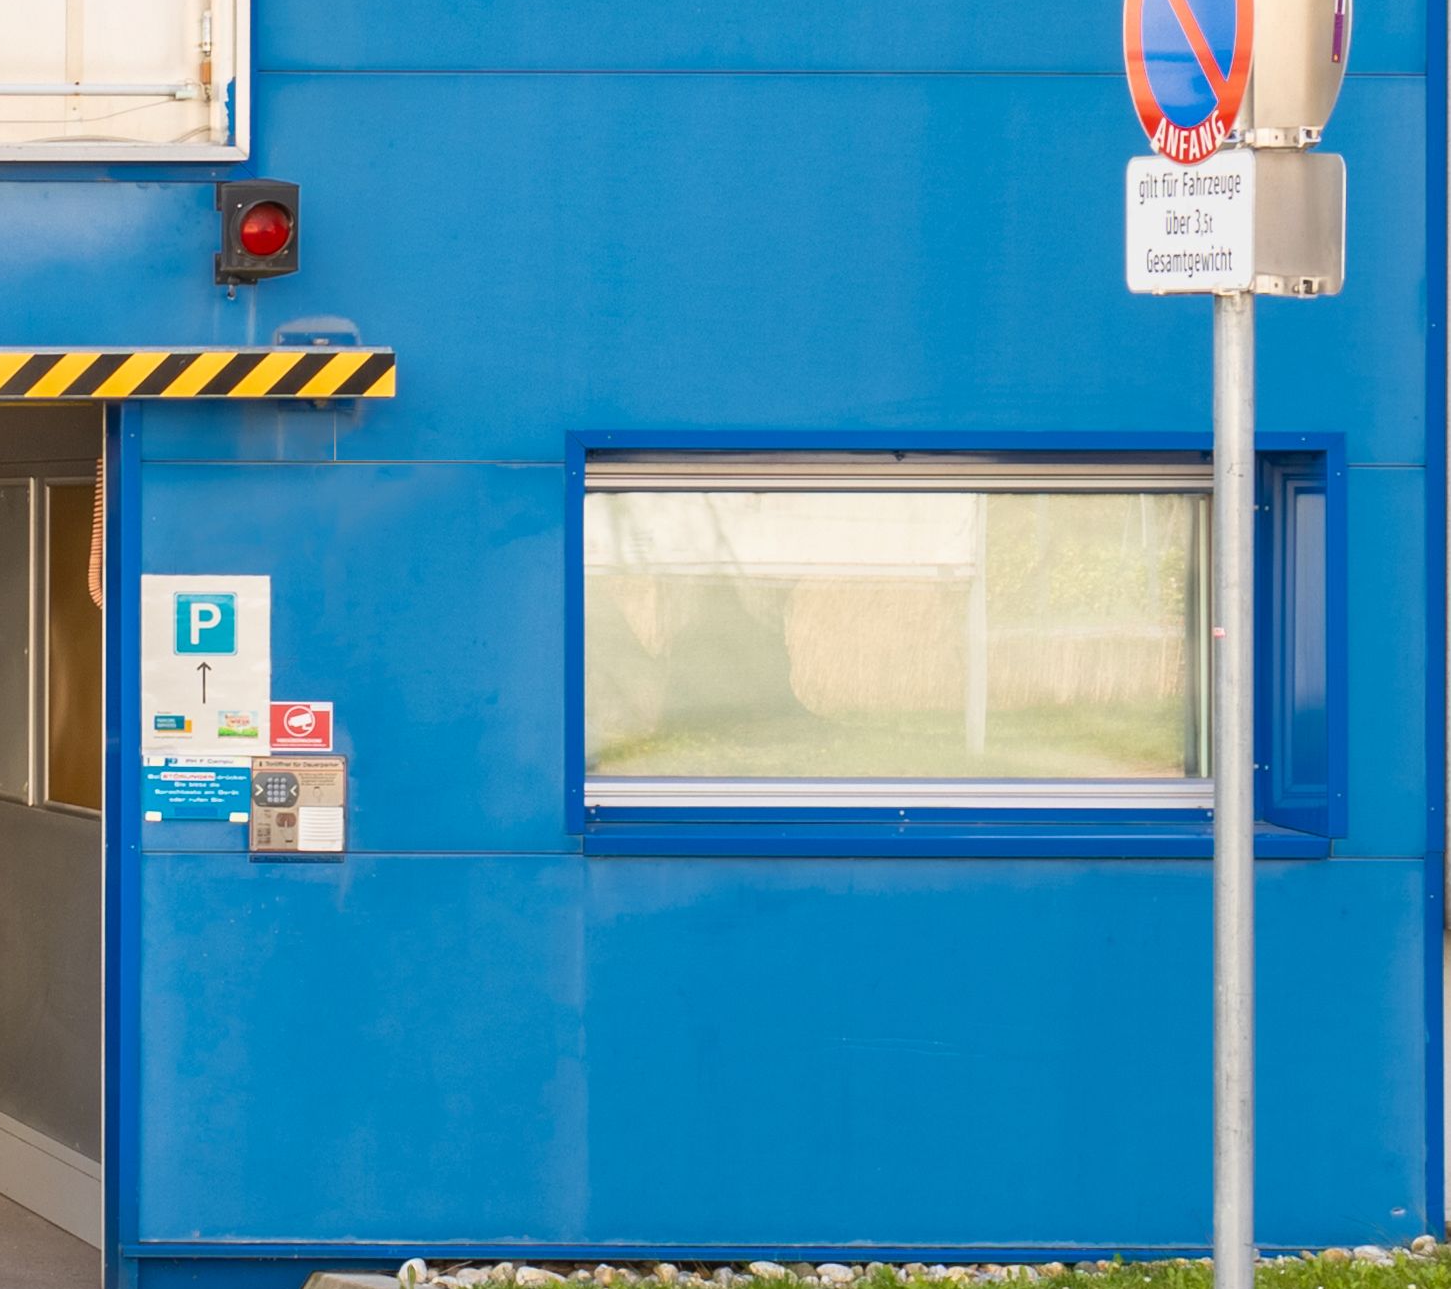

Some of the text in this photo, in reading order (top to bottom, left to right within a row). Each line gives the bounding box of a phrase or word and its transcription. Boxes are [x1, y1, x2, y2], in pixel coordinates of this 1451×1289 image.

[1153, 110, 1225, 160] ANFANG
[1139, 171, 1241, 205] gilt für Fahrzeuge
[1165, 209, 1213, 236] über 3,5t
[1146, 246, 1233, 278] Gesamtgewicht
[189, 602, 222, 645] P
